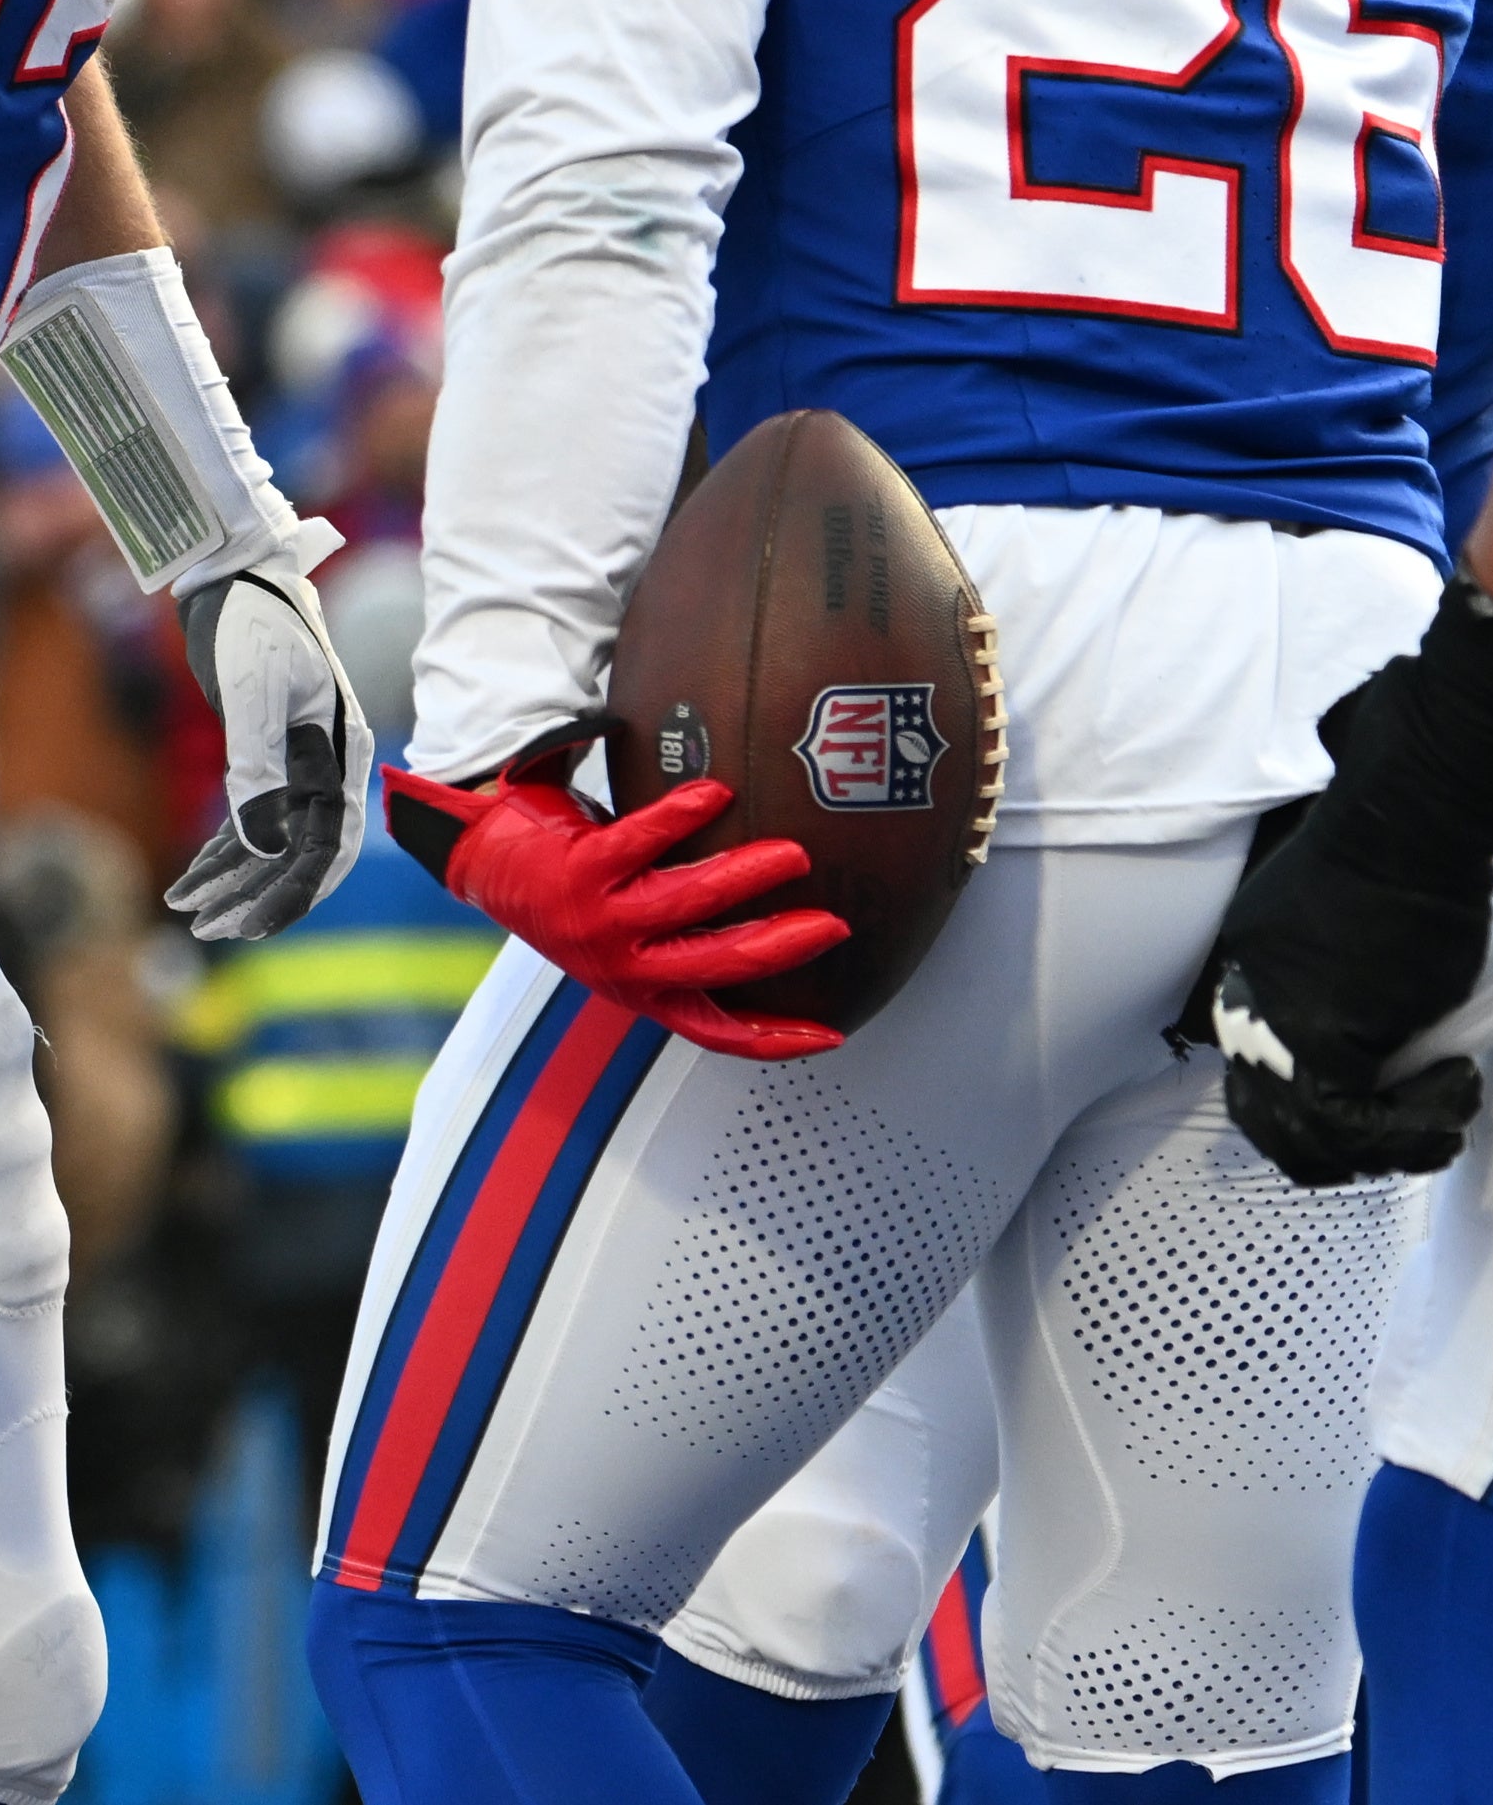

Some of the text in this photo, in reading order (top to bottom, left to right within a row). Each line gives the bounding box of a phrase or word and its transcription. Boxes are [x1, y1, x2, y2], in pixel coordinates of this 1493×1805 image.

[676, 702, 690, 718] 20
[660, 730, 684, 774] 180
[817, 699, 887, 798] NFL
